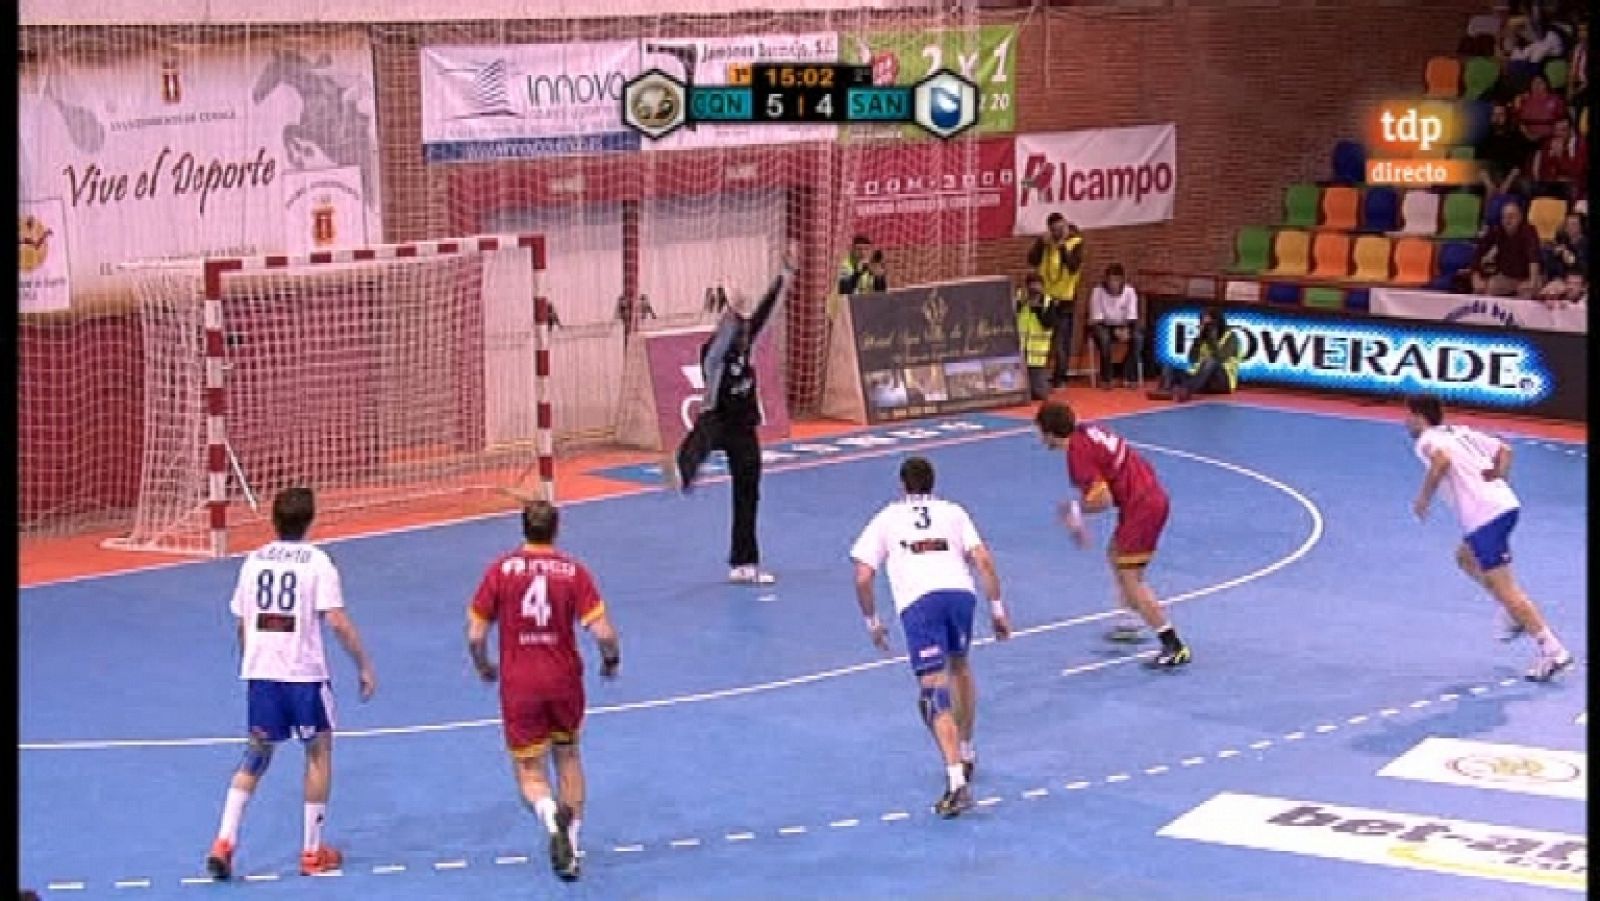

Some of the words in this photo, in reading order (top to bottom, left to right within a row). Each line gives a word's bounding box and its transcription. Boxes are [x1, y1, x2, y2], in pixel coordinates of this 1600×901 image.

[991, 35, 1015, 83] 1
[63, 153, 128, 208] Vive
[135, 146, 171, 199] el
[172, 147, 276, 216] Deporte
[1020, 152, 1173, 207] Alcampo
[912, 506, 932, 530] 3
[256, 568, 297, 611] 88
[520, 574, 553, 627] 4
